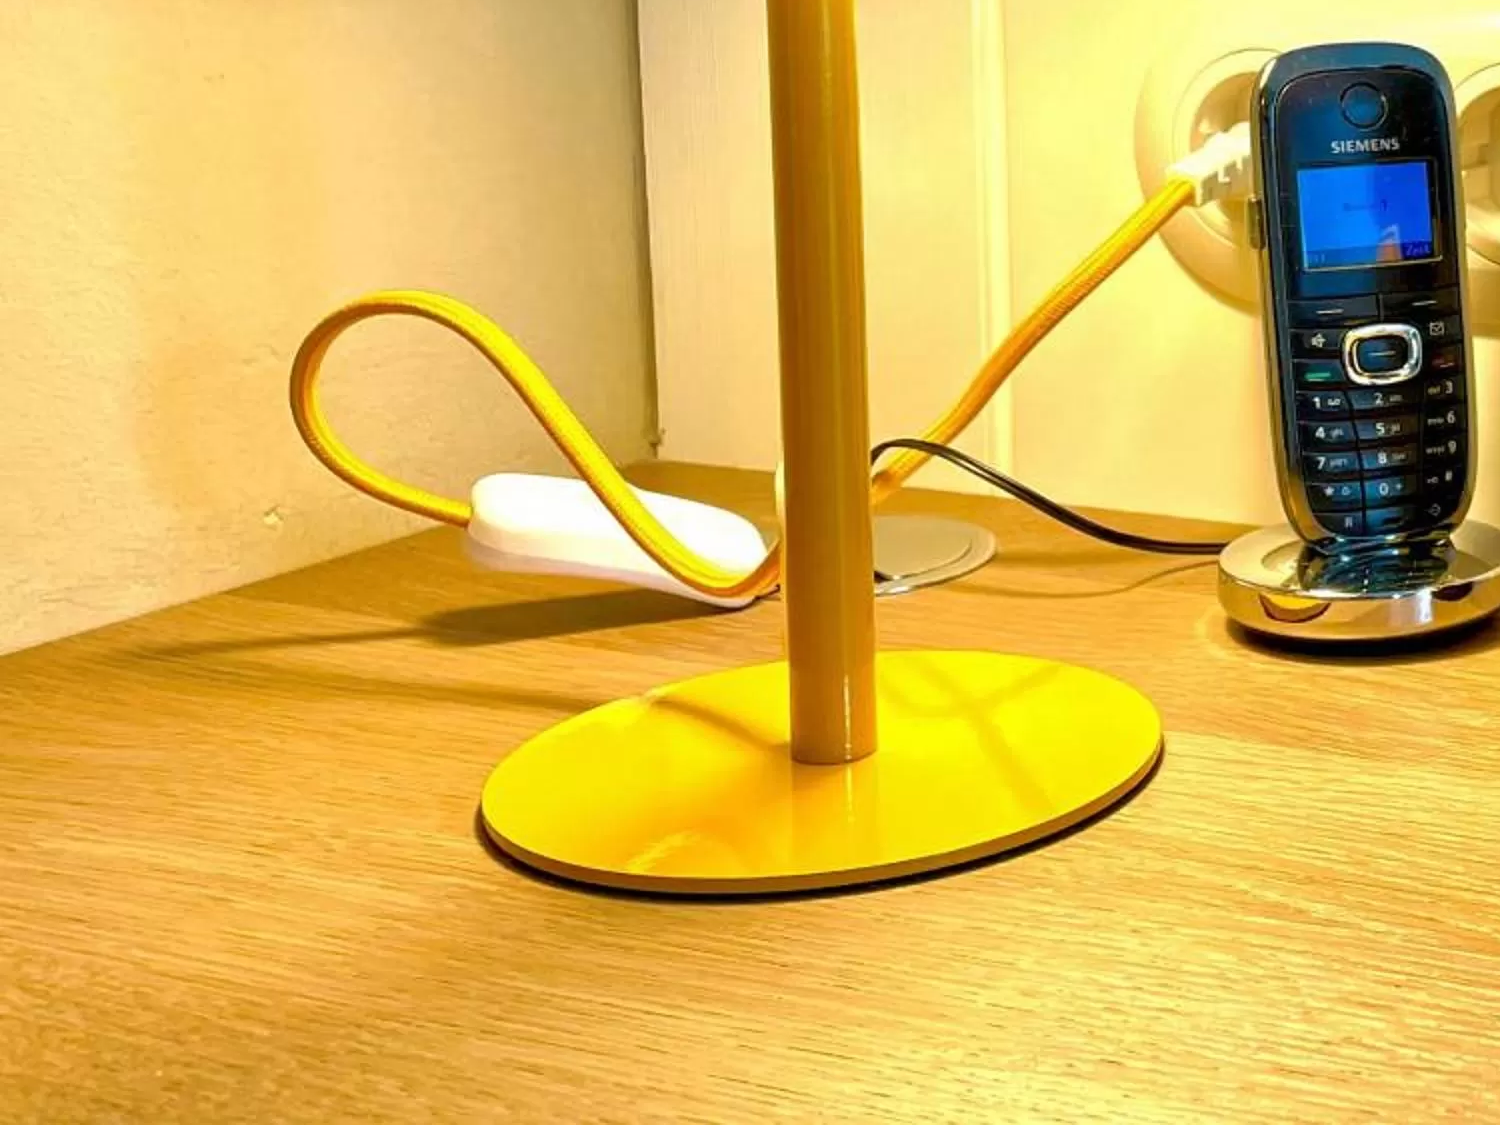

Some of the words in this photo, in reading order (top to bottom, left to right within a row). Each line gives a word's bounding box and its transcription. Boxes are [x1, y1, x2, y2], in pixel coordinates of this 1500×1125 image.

[1330, 138, 1400, 154] SIEMENS
[1373, 391, 1384, 405] 2
[1446, 410, 1456, 424] 6
[1314, 426, 1326, 439] 4
[1375, 422, 1385, 436] 5
[1316, 456, 1326, 470] 7
